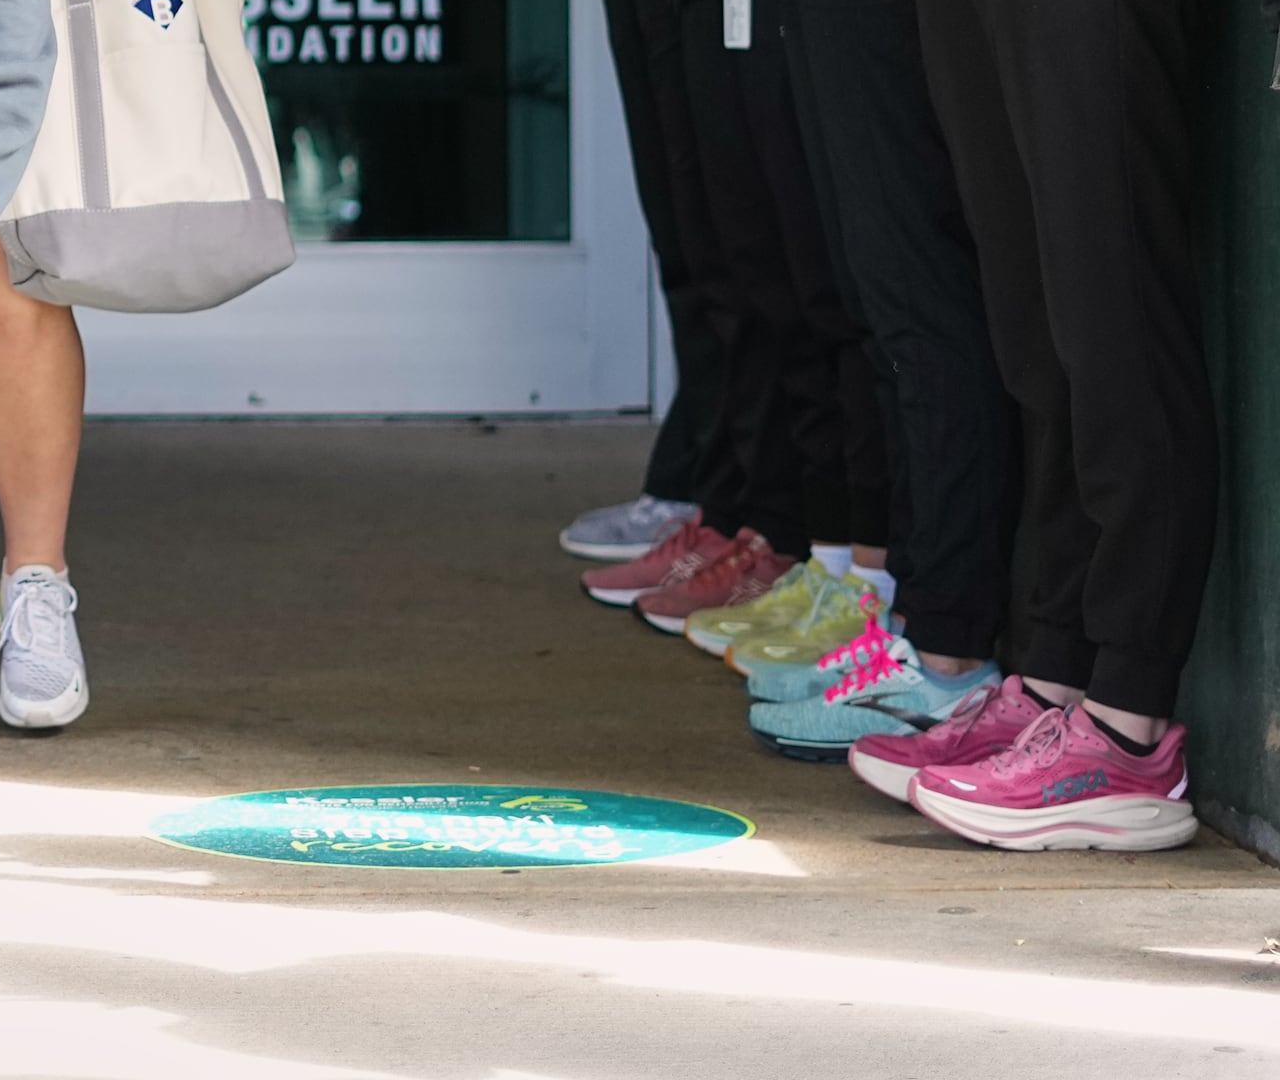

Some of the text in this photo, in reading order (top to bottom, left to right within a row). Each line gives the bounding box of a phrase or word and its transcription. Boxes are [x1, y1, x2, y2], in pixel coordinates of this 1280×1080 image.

[244, 24, 441, 62] NDATION
[1042, 768, 1109, 806] HOKA
[440, 814, 556, 827] next
[290, 825, 616, 840] step toward
[290, 838, 643, 858] recovery
